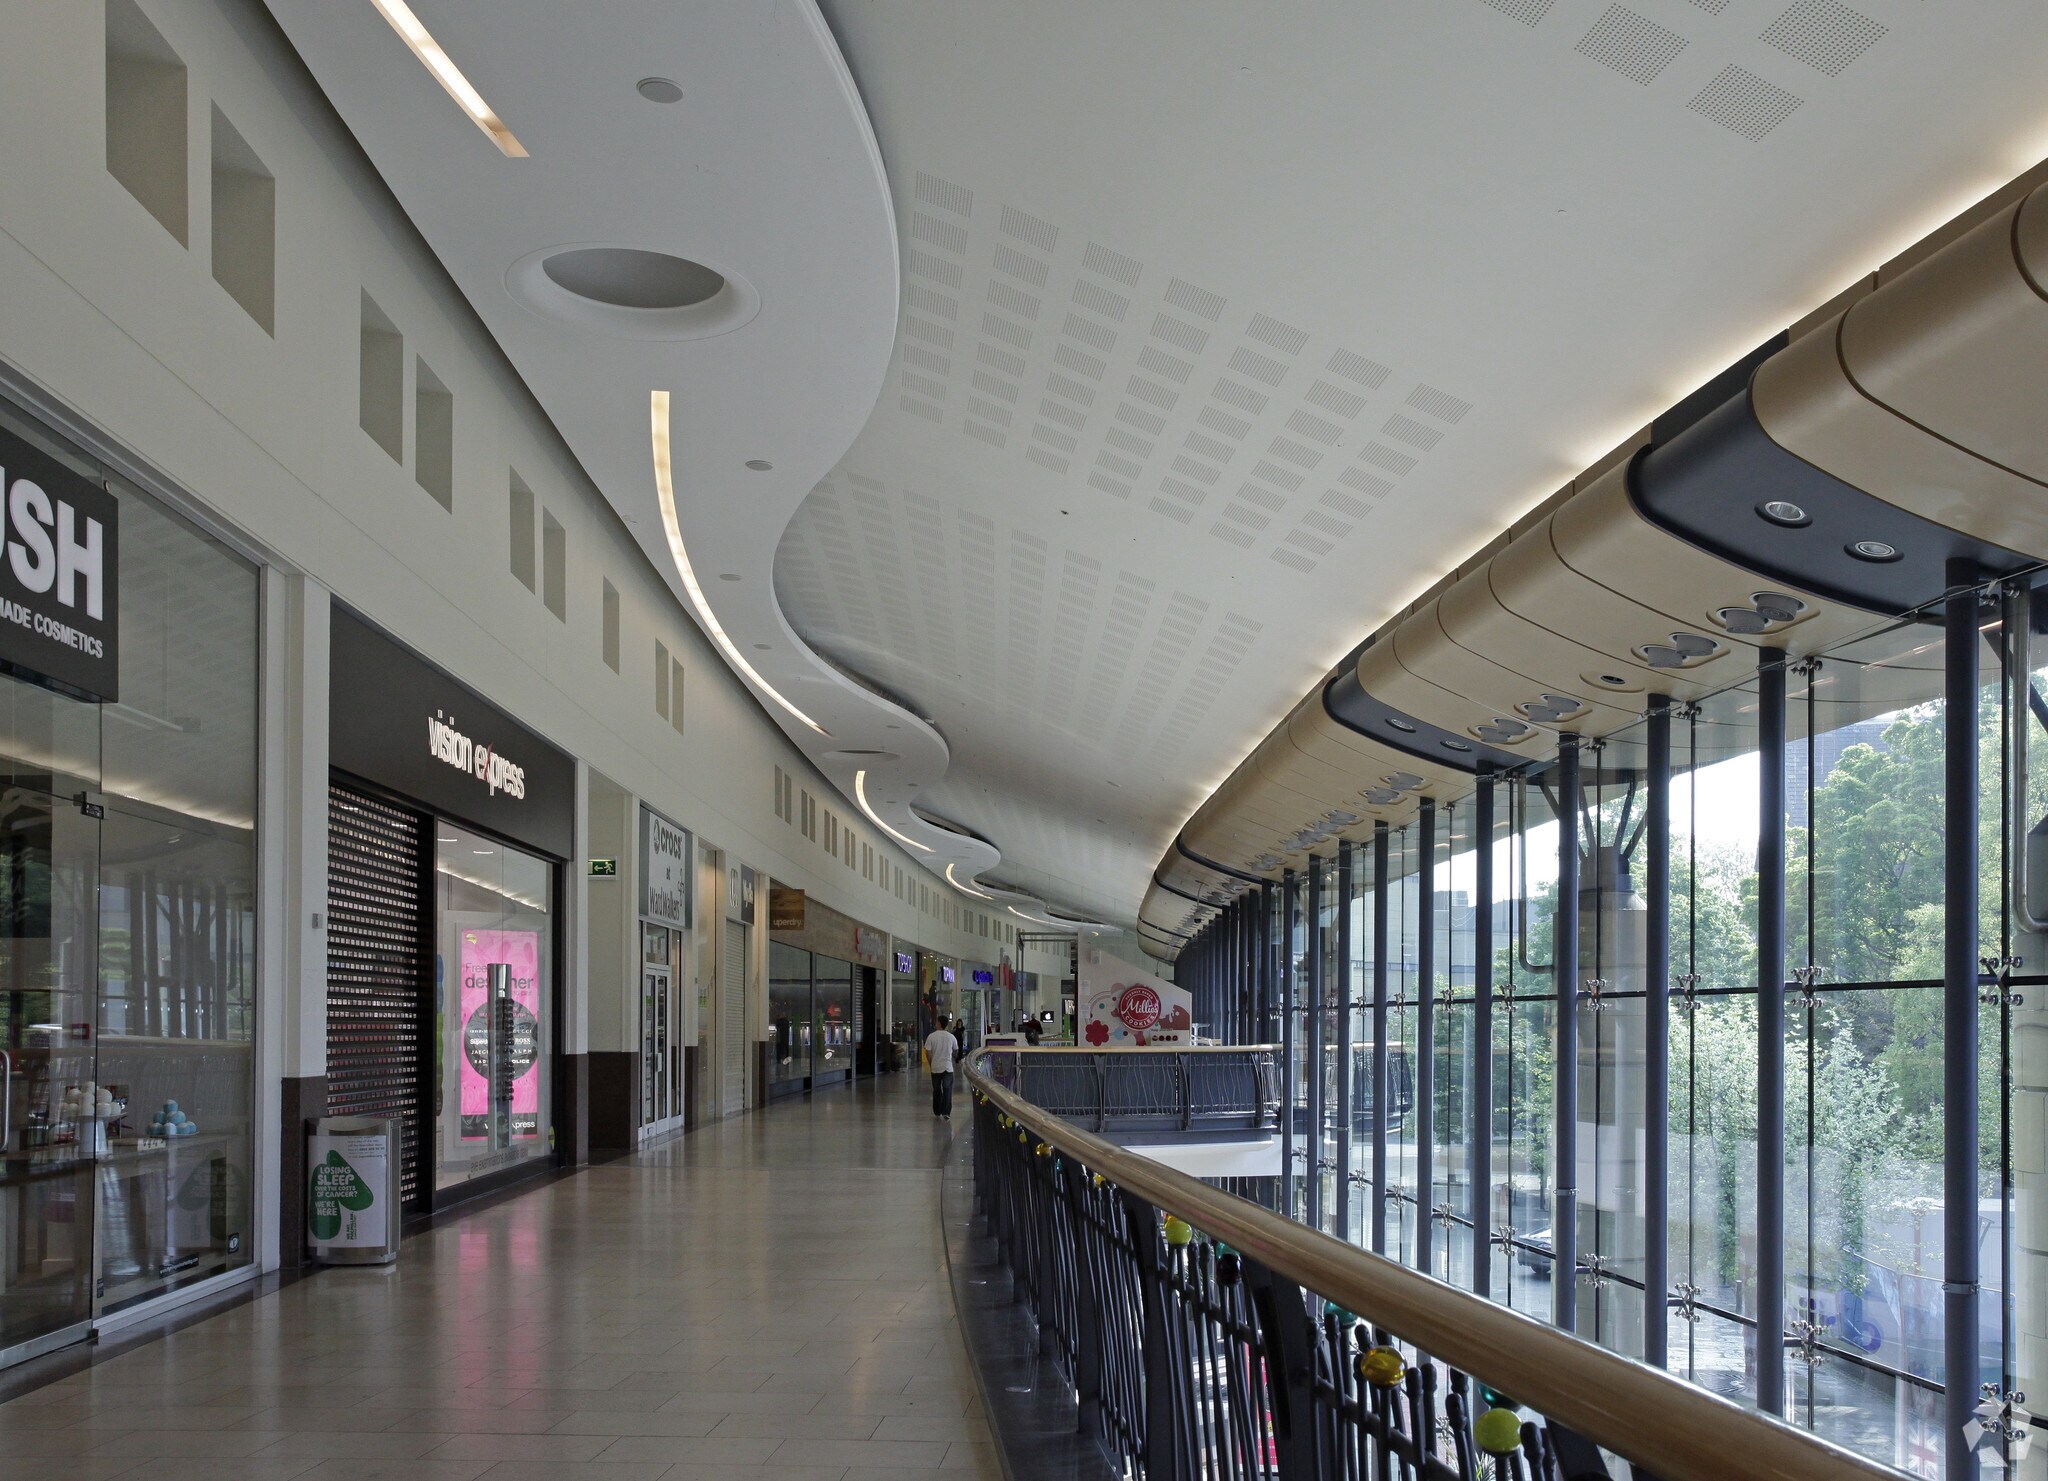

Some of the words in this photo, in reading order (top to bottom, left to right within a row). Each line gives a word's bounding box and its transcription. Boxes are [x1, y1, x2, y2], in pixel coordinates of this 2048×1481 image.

[0, 465, 103, 621] SH
[34, 613, 103, 659] COSMETICS
[428, 709, 473, 774] vision
[474, 741, 525, 800] express
[660, 826, 682, 861] crocs
[1125, 1014, 1156, 1026] COOKIES
[320, 1166, 351, 1175] LOSING
[317, 1174, 355, 1186] SLEEP
[314, 1200, 336, 1208] WE'RE
[316, 1207, 338, 1216] HERE
